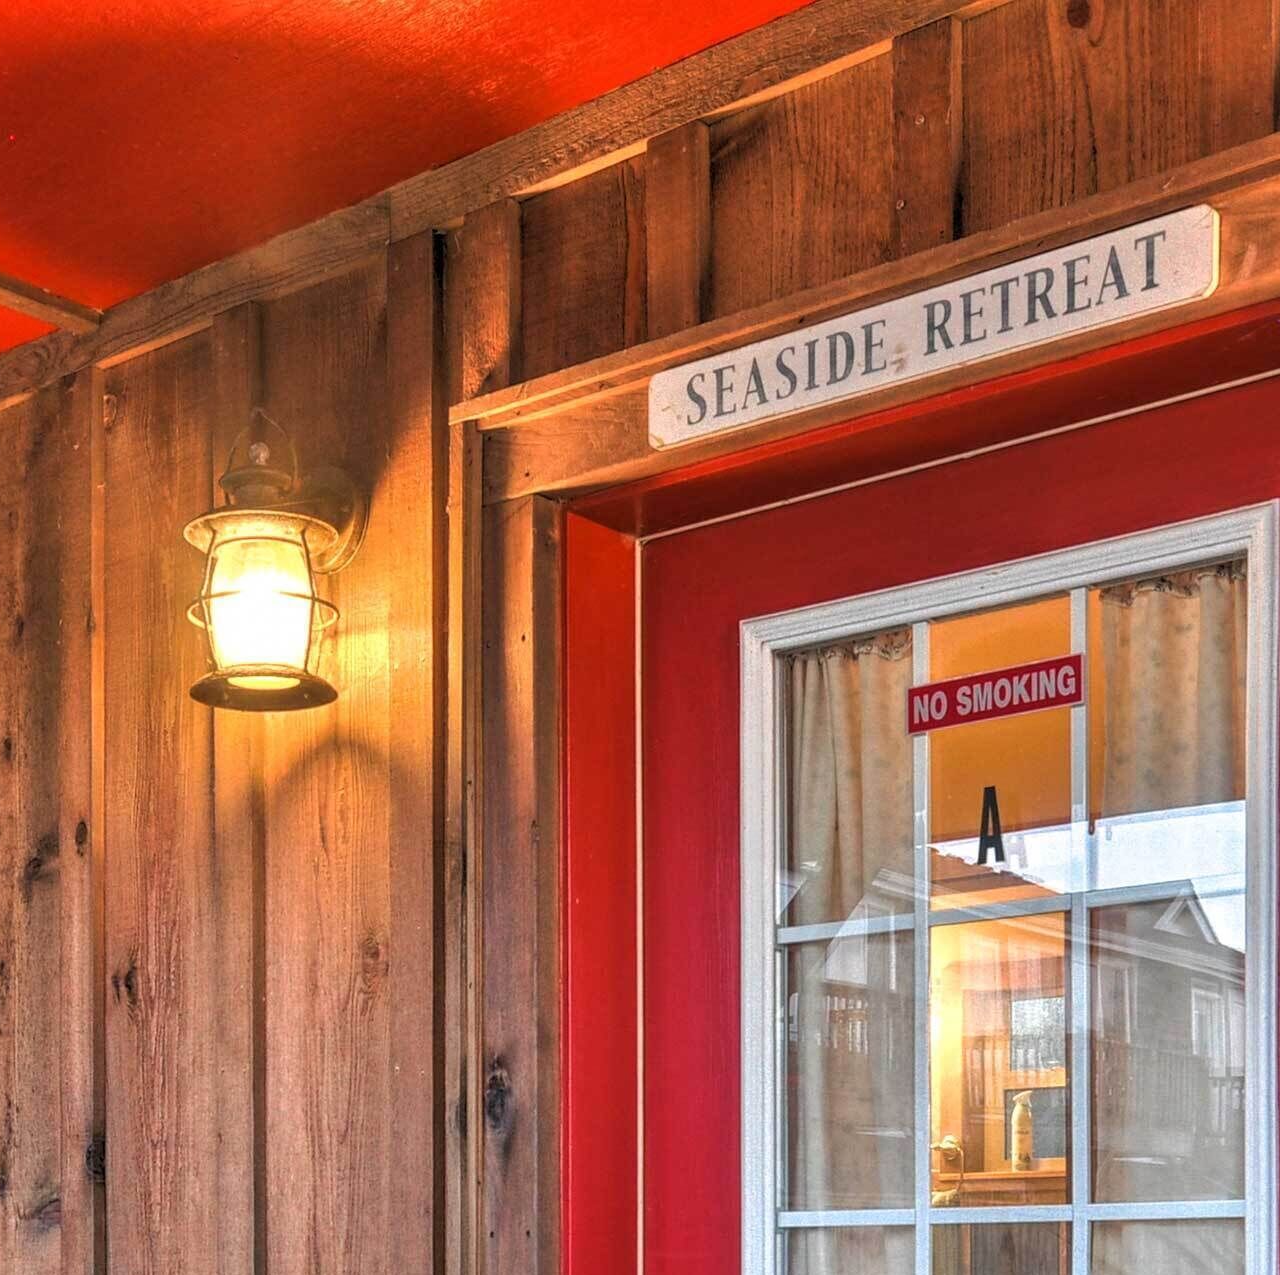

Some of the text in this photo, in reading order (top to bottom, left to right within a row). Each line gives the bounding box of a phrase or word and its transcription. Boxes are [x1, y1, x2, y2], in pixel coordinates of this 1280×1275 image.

[685, 230, 1167, 426] SEASIDE RETREAT
[913, 665, 1076, 724] NO SMOKING
[977, 785, 1005, 865] A
